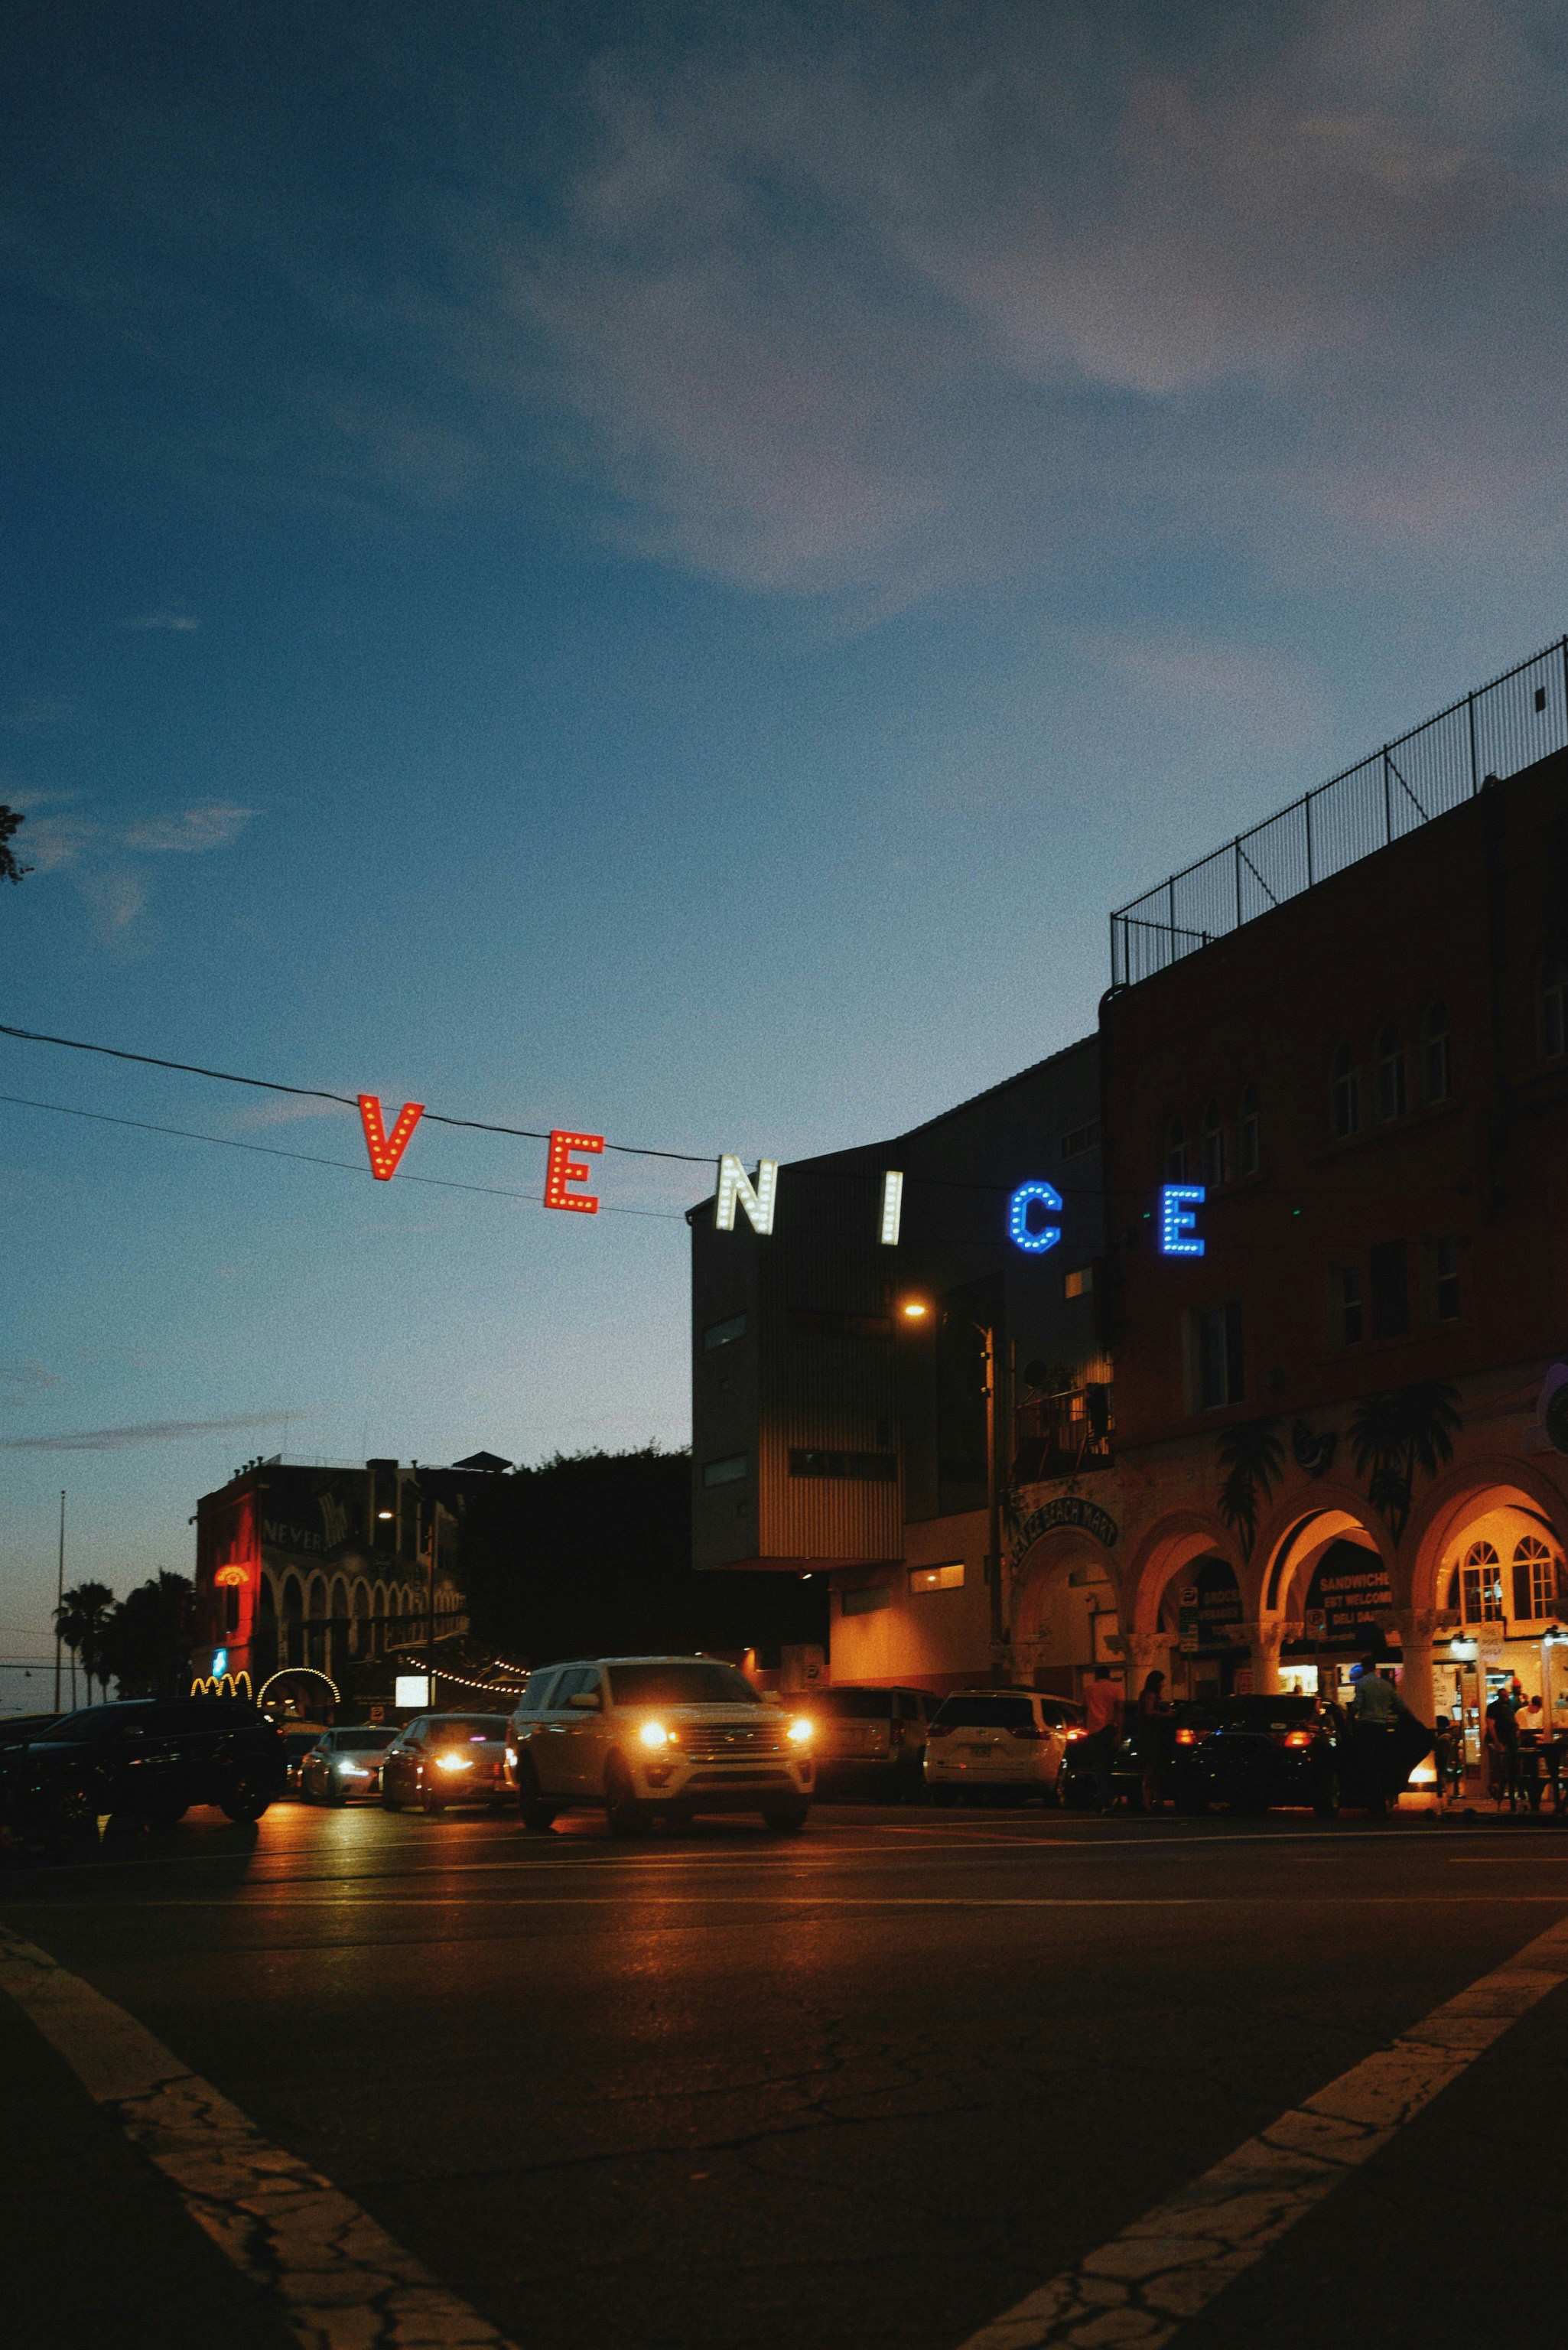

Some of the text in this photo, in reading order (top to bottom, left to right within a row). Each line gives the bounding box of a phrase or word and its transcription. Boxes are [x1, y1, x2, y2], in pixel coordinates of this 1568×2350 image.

[357, 1093, 1206, 1257] VENICE
[263, 1518, 321, 1551] NEVER
[1043, 1500, 1079, 1528] BEACH
[1083, 1504, 1115, 1544] MART
[1324, 1595, 1342, 1608] EBT
[1332, 1612, 1355, 1625] DELI
